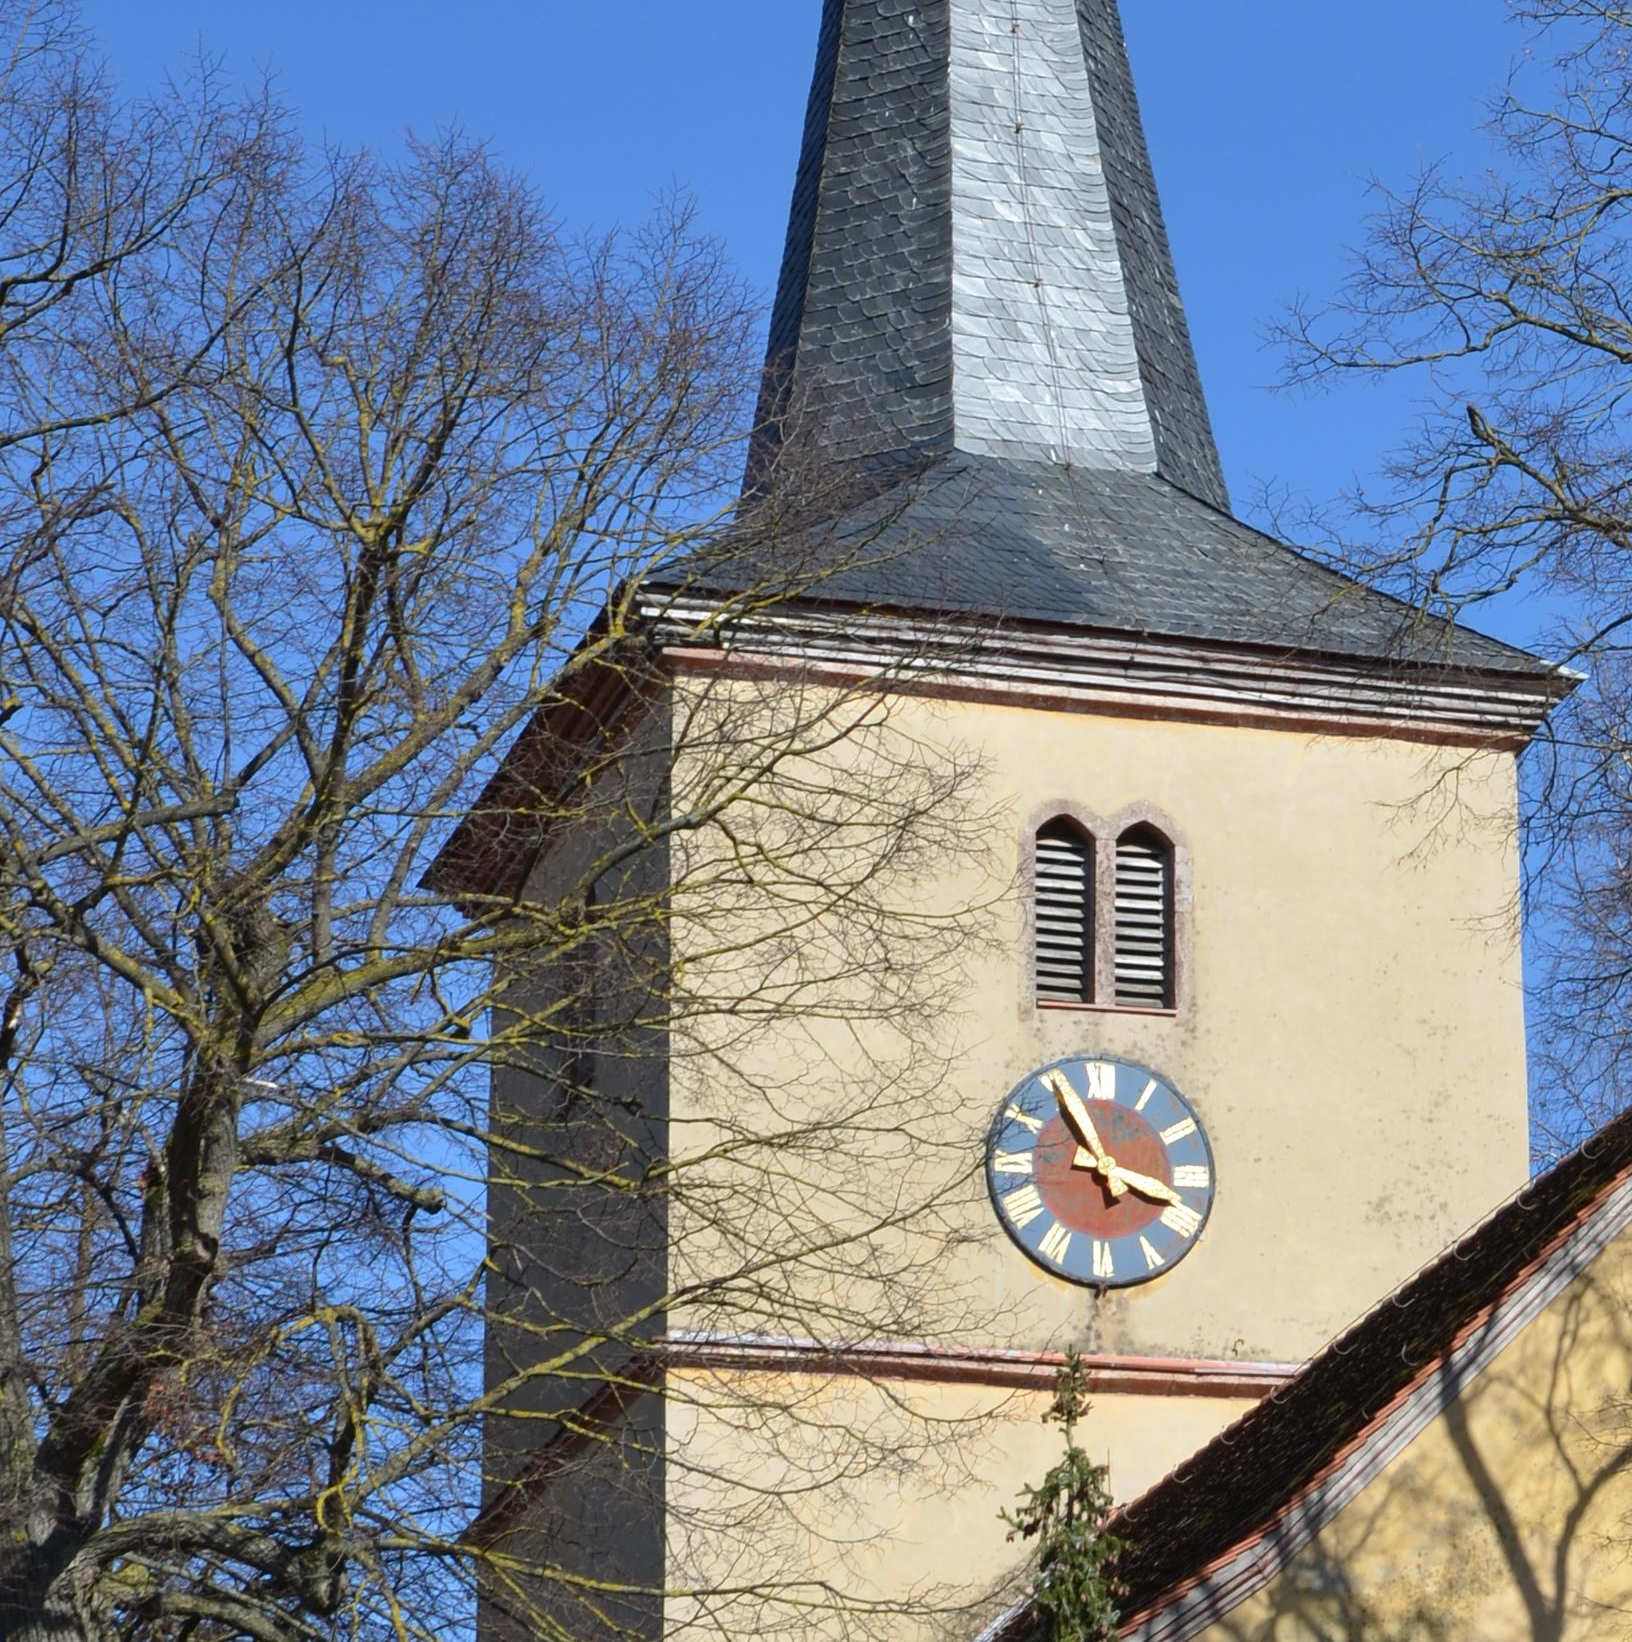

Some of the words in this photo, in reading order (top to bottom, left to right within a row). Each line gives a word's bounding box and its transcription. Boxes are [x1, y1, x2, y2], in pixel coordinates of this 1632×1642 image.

[1085, 1062, 1116, 1100] XII
[1004, 1103, 1043, 1134] X
[1159, 1116, 1197, 1146] II
[994, 1149, 1033, 1174] IX
[1173, 1164, 1210, 1189] III
[1002, 1184, 1045, 1231] VIII
[1038, 1221, 1072, 1264] VII
[1092, 1239, 1115, 1278] VI
[1139, 1234, 1166, 1270] V
